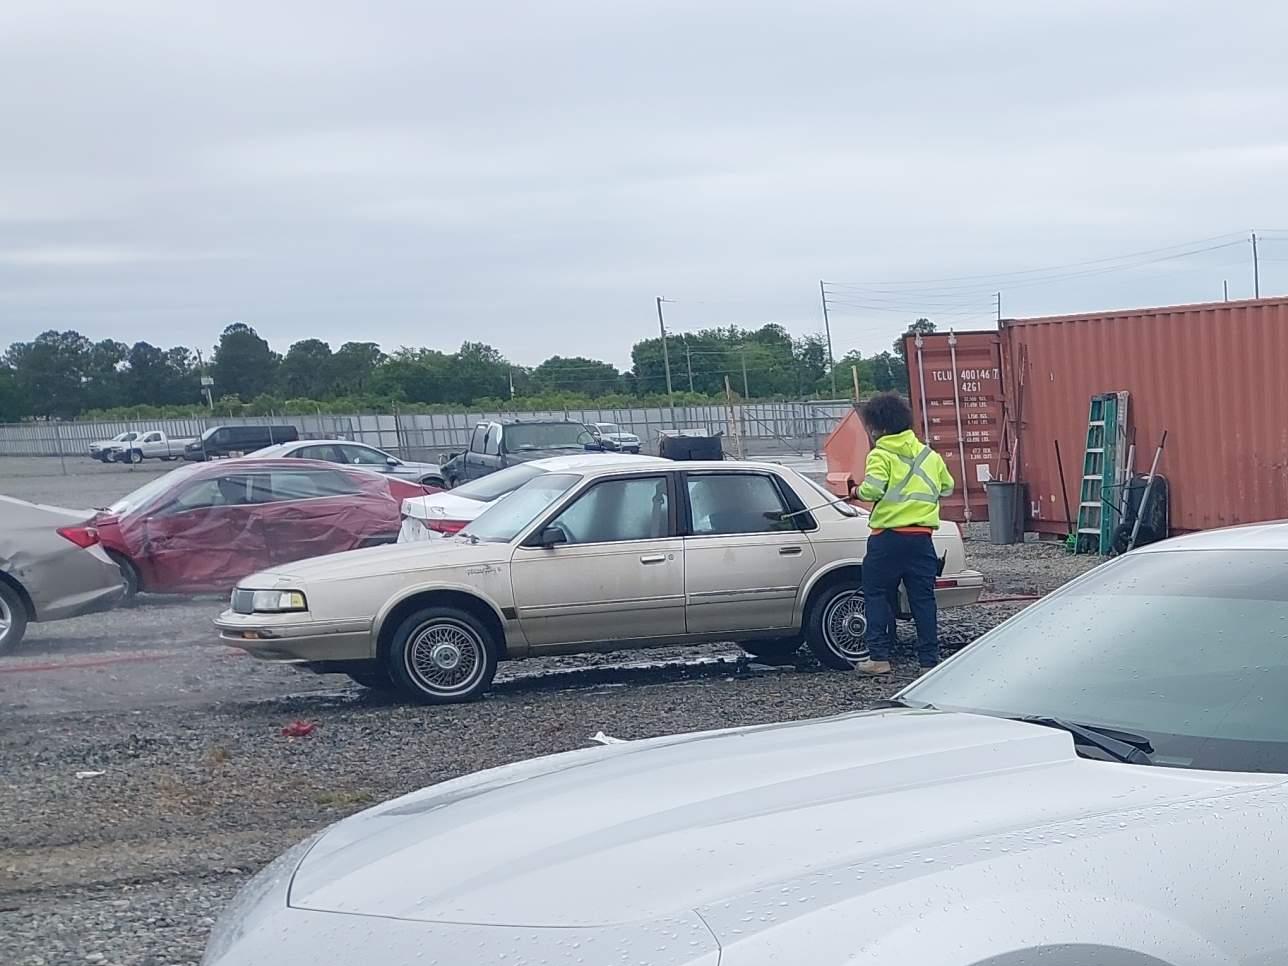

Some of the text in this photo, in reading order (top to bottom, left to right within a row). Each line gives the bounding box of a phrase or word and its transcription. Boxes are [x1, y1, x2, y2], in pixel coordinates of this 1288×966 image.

[932, 371, 952, 381] TCLU
[961, 369, 990, 380] 400146
[962, 382, 981, 391] 42G1
